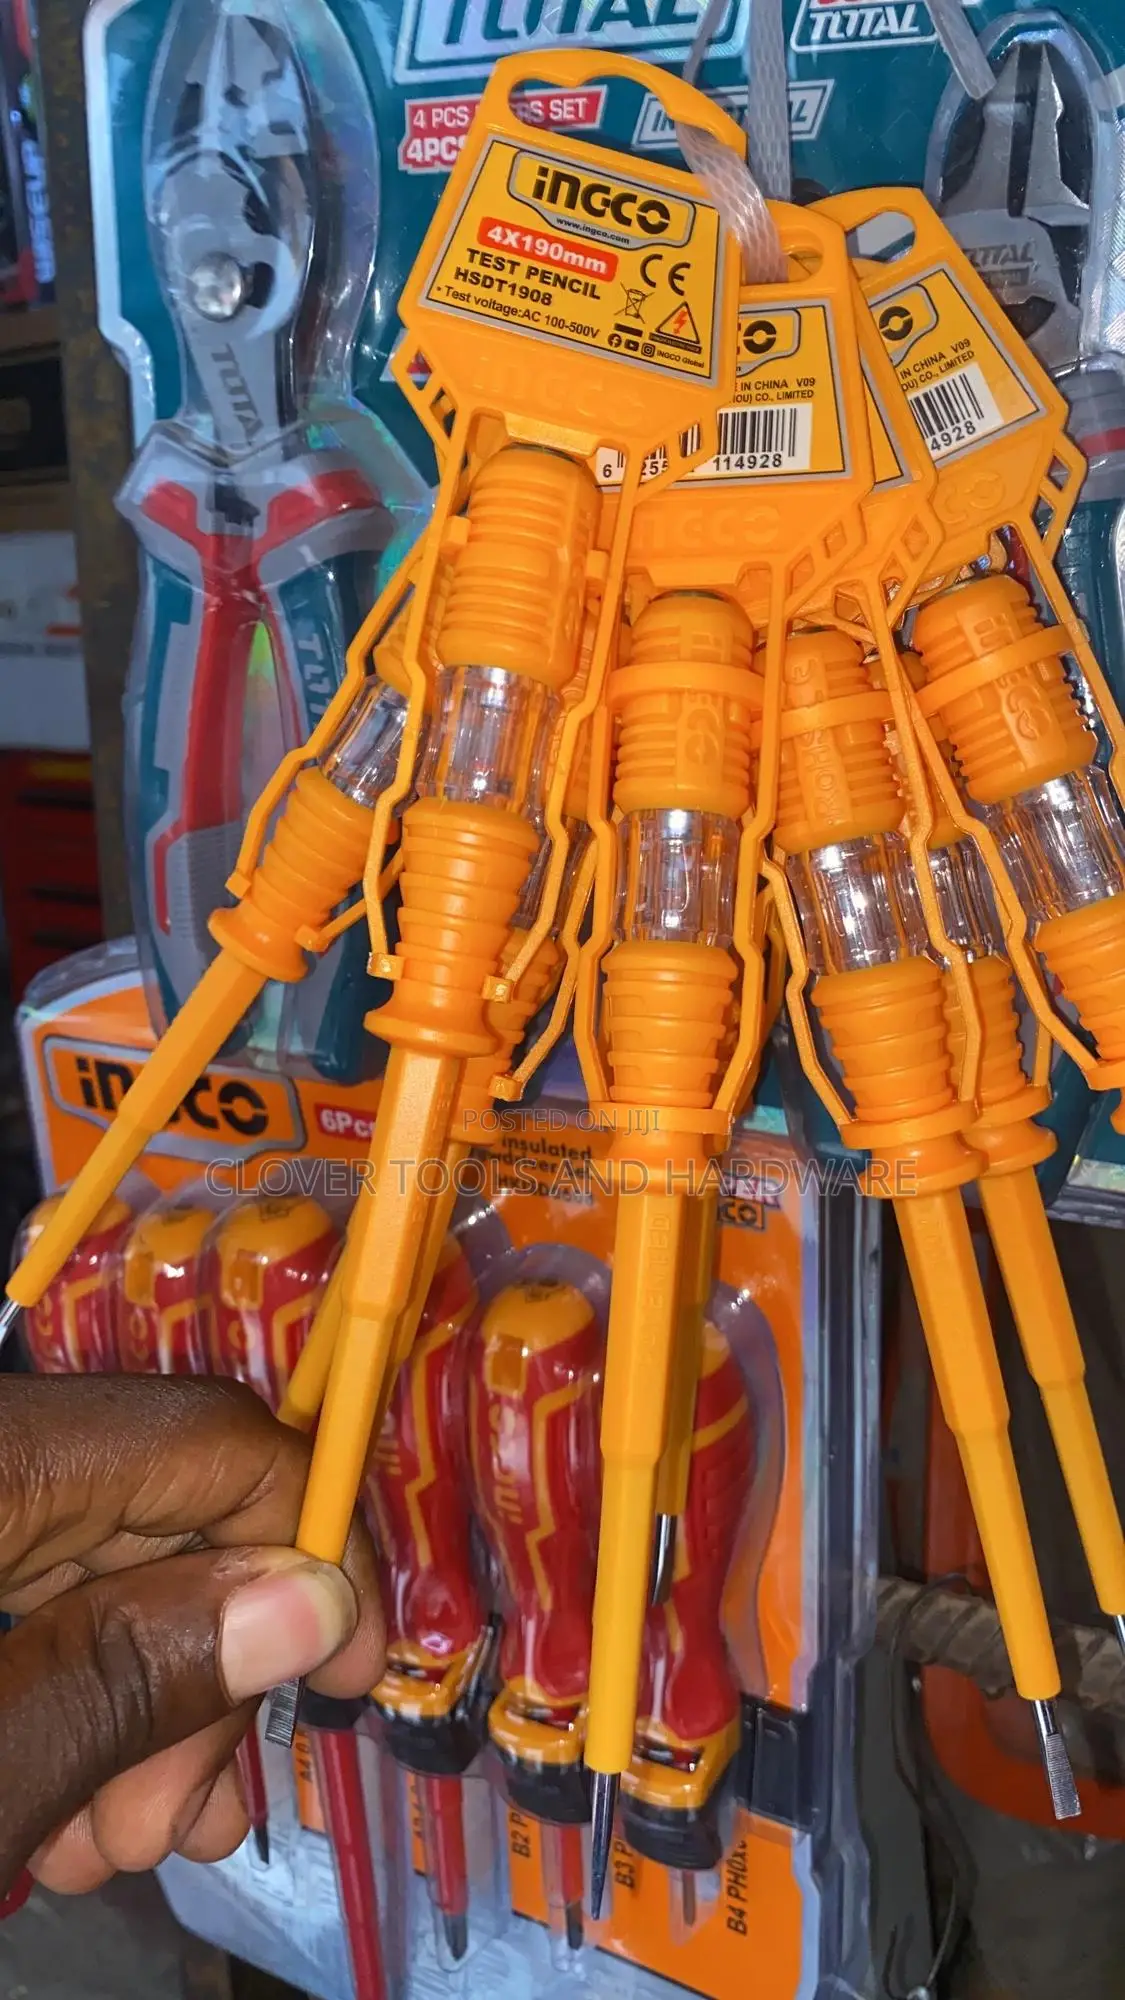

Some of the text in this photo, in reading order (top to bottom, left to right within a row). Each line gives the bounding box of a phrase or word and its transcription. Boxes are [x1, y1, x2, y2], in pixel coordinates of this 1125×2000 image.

[809, 4, 920, 41] TOTAL
[413, 109, 427, 130] 4
[431, 106, 470, 128] PCS
[549, 97, 588, 121] SET
[556, 216, 630, 245] www.ingco.com
[487, 225, 607, 275] 4X190mm
[454, 266, 552, 306] HSDT1908
[467, 248, 601, 300] TEST PENCIL
[446, 286, 471, 303] Test
[544, 313, 600, 339] 100-500V
[900, 338, 971, 380] IN CHINA V09
[939, 350, 975, 374] LIMITED
[740, 378, 816, 391] IN CHINA V09
[776, 390, 814, 401] LIMITED
[930, 419, 977, 452] 4928
[602, 463, 612, 478] 6
[712, 453, 783, 472] 114928
